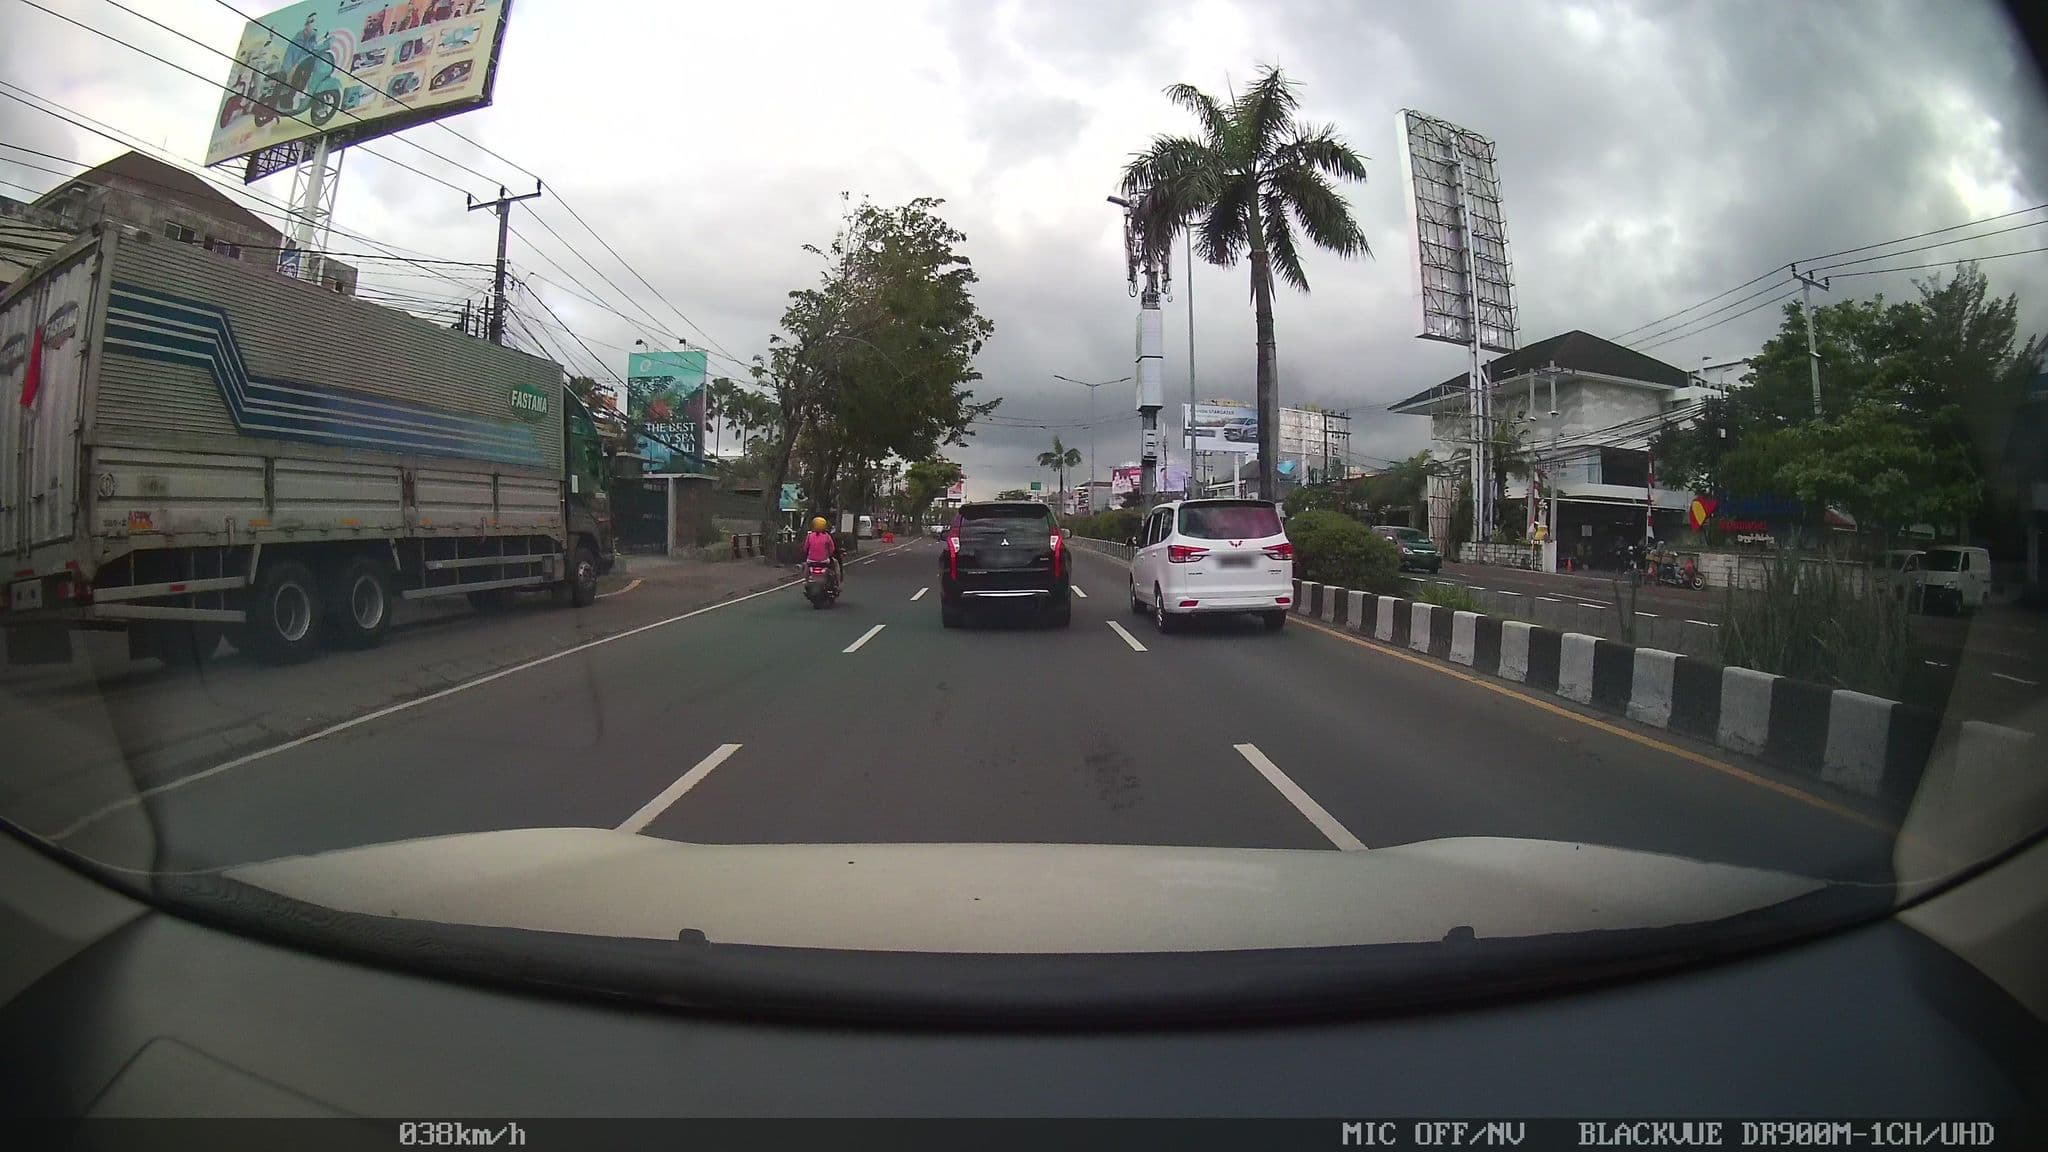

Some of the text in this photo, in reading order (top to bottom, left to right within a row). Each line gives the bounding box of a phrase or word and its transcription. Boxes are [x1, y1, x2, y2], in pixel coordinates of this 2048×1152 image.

[511, 390, 547, 413] FASTANA
[644, 422, 696, 432] THE BEST
[675, 433, 696, 443] SPA
